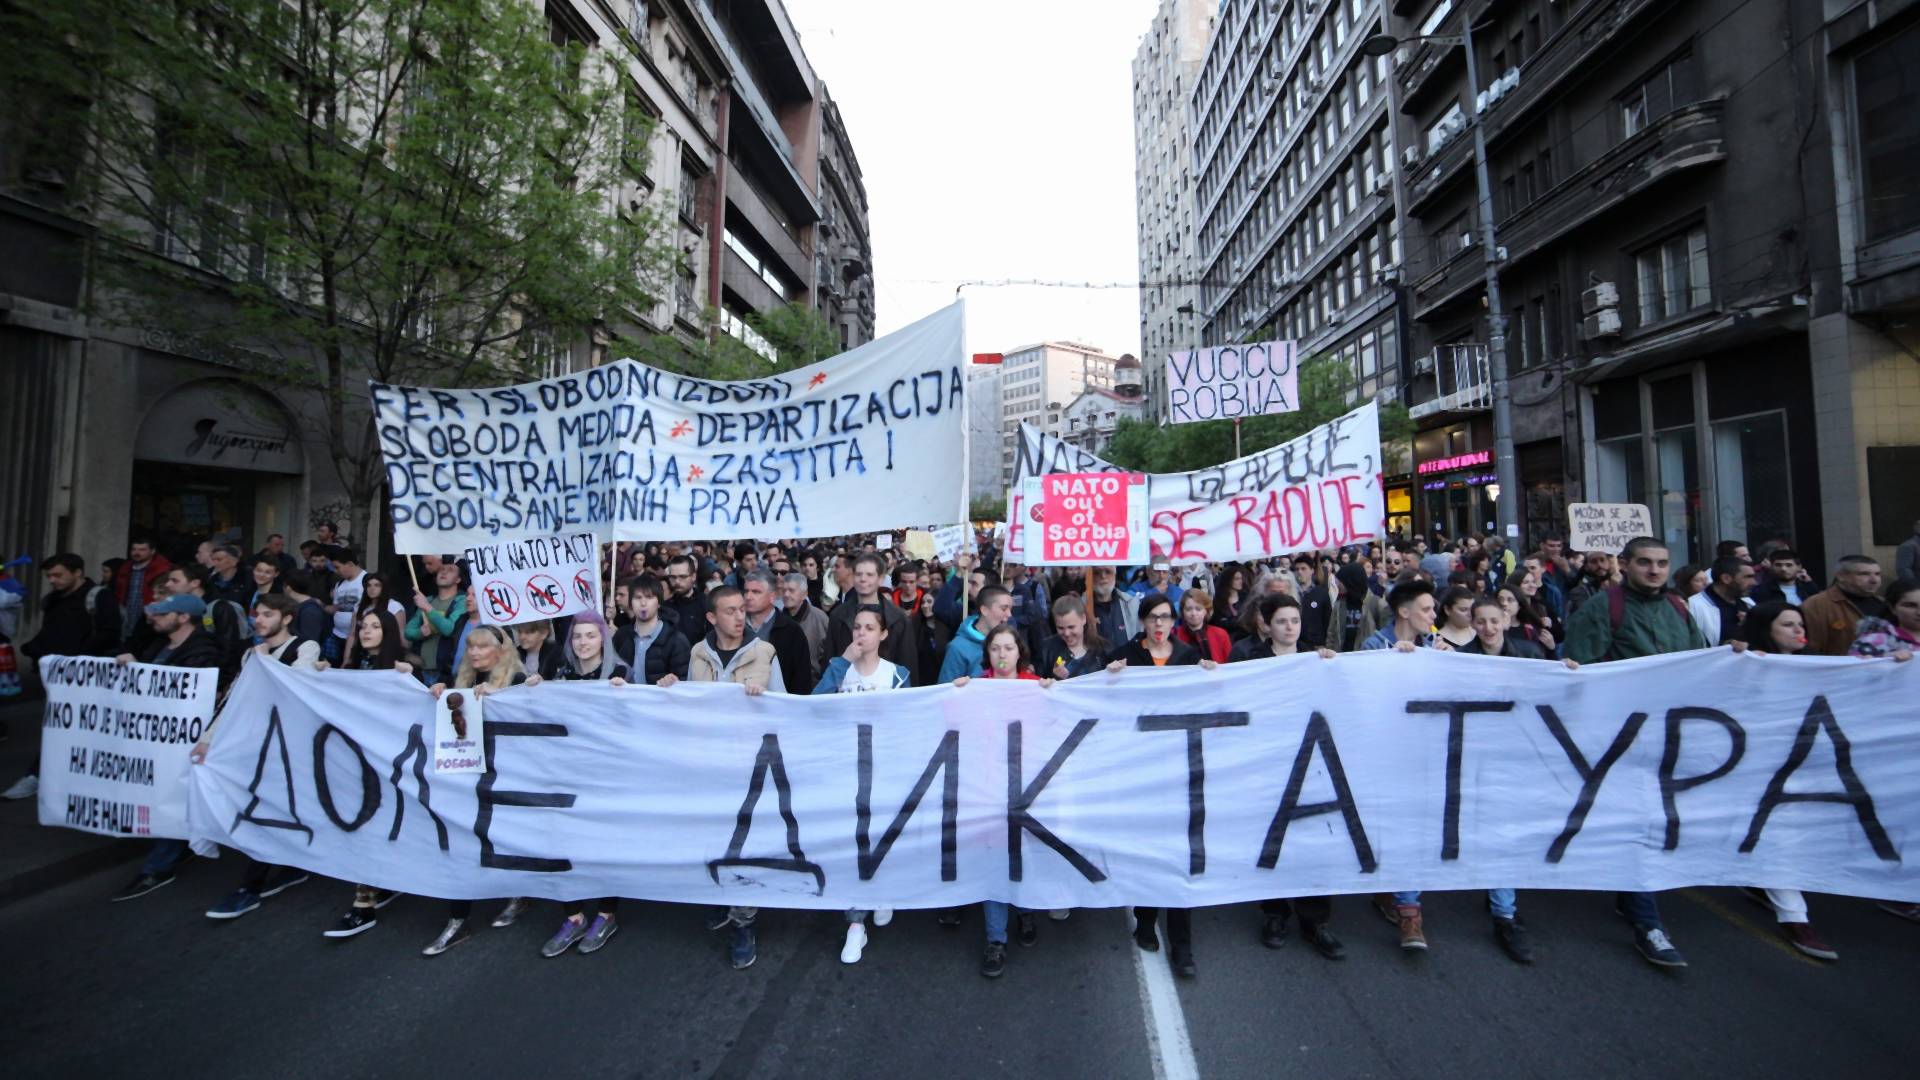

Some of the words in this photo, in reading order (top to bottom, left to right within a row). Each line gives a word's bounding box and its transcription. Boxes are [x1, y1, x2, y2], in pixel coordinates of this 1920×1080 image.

[370, 383, 464, 421] FER
[471, 392, 490, 416] I
[491, 364, 660, 416] SLOBODNI
[1172, 378, 1290, 421] ROBIJA
[381, 421, 547, 461] SLOBODA
[558, 404, 656, 452] MEDIJA
[697, 366, 963, 447] DEPARTIZACIJA
[387, 449, 681, 498] DECENTRALIZACIJA
[710, 438, 866, 484] ZAŠTITA
[1012, 423, 1123, 488] NAR
[587, 488, 668, 523] RADNIH
[689, 488, 800, 525] PRAVA
[1052, 477, 1120, 496] NATO
[1062, 494, 1104, 510] out
[1048, 522, 1126, 541] Serbia
[1071, 508, 1097, 526] of
[1150, 507, 1207, 559] SE
[464, 544, 503, 575] FUCK
[507, 538, 549, 571] NATO
[1053, 541, 1119, 558] now
[489, 587, 512, 615] EU
[47, 659, 121, 690] ИНФОРМЕР
[79, 704, 98, 730] КО
[114, 709, 202, 744] УЧЕСТВОВАО
[69, 746, 86, 774] НА
[90, 749, 154, 786] ИЗБОРИМА
[66, 793, 98, 828] НИЈЕ
[100, 800, 134, 833] НАШ
[230, 705, 576, 872] ДОЛЕ
[705, 695, 1901, 897] ДИКТАТУРА
